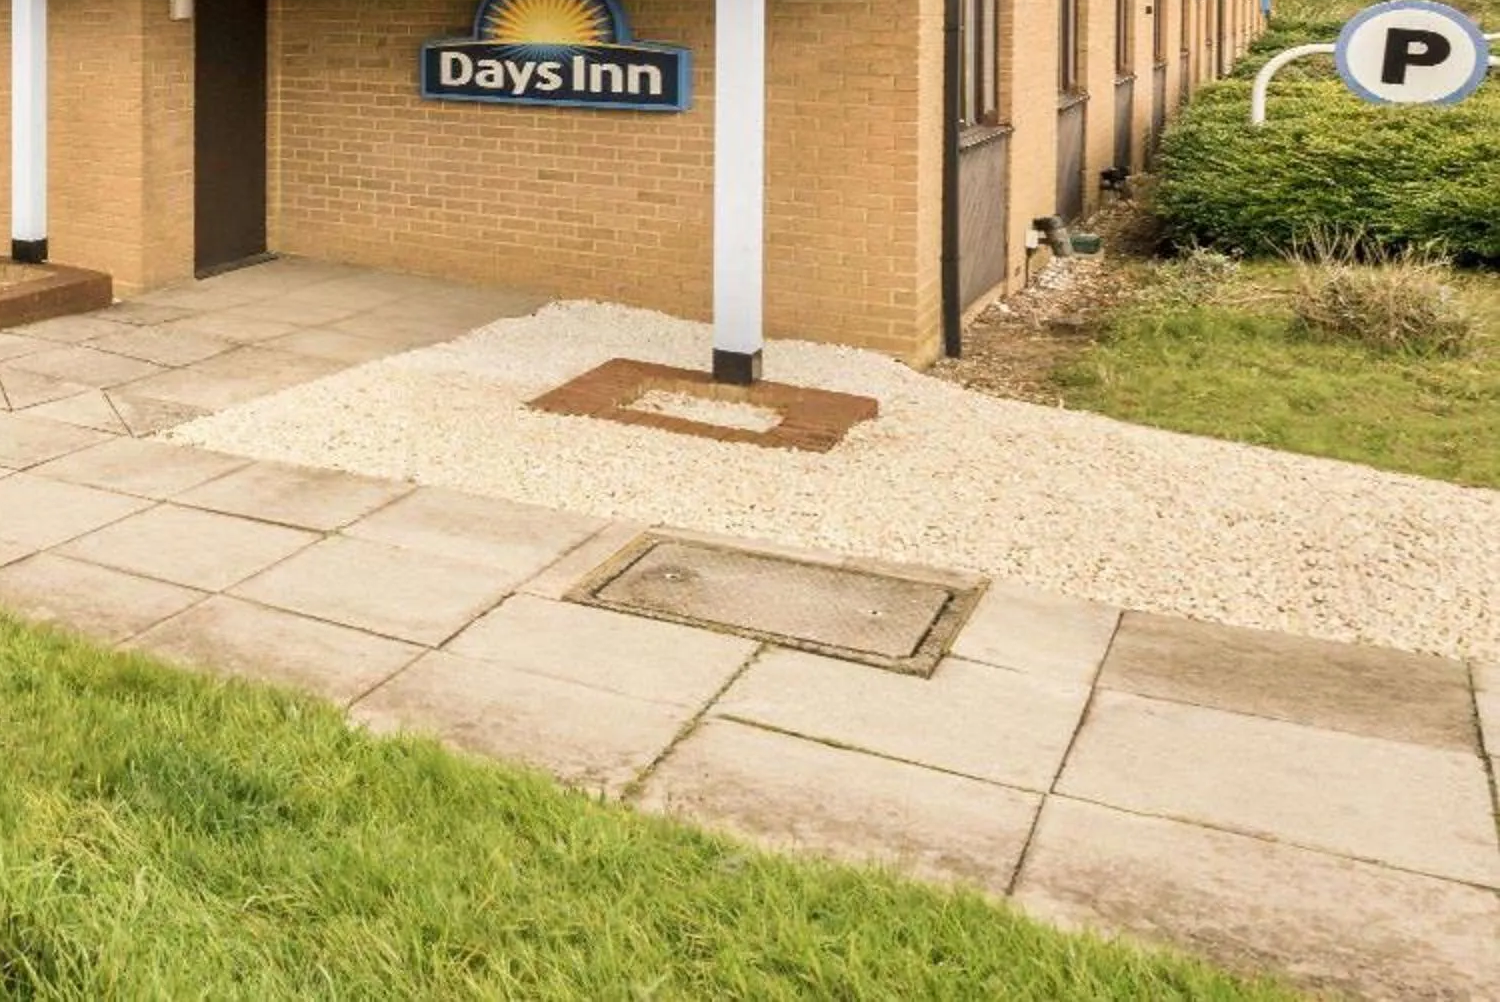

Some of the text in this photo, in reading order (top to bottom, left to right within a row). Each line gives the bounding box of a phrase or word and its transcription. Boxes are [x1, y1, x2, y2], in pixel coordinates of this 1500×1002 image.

[439, 51, 663, 95] Days Inn
[1381, 27, 1451, 85] P
